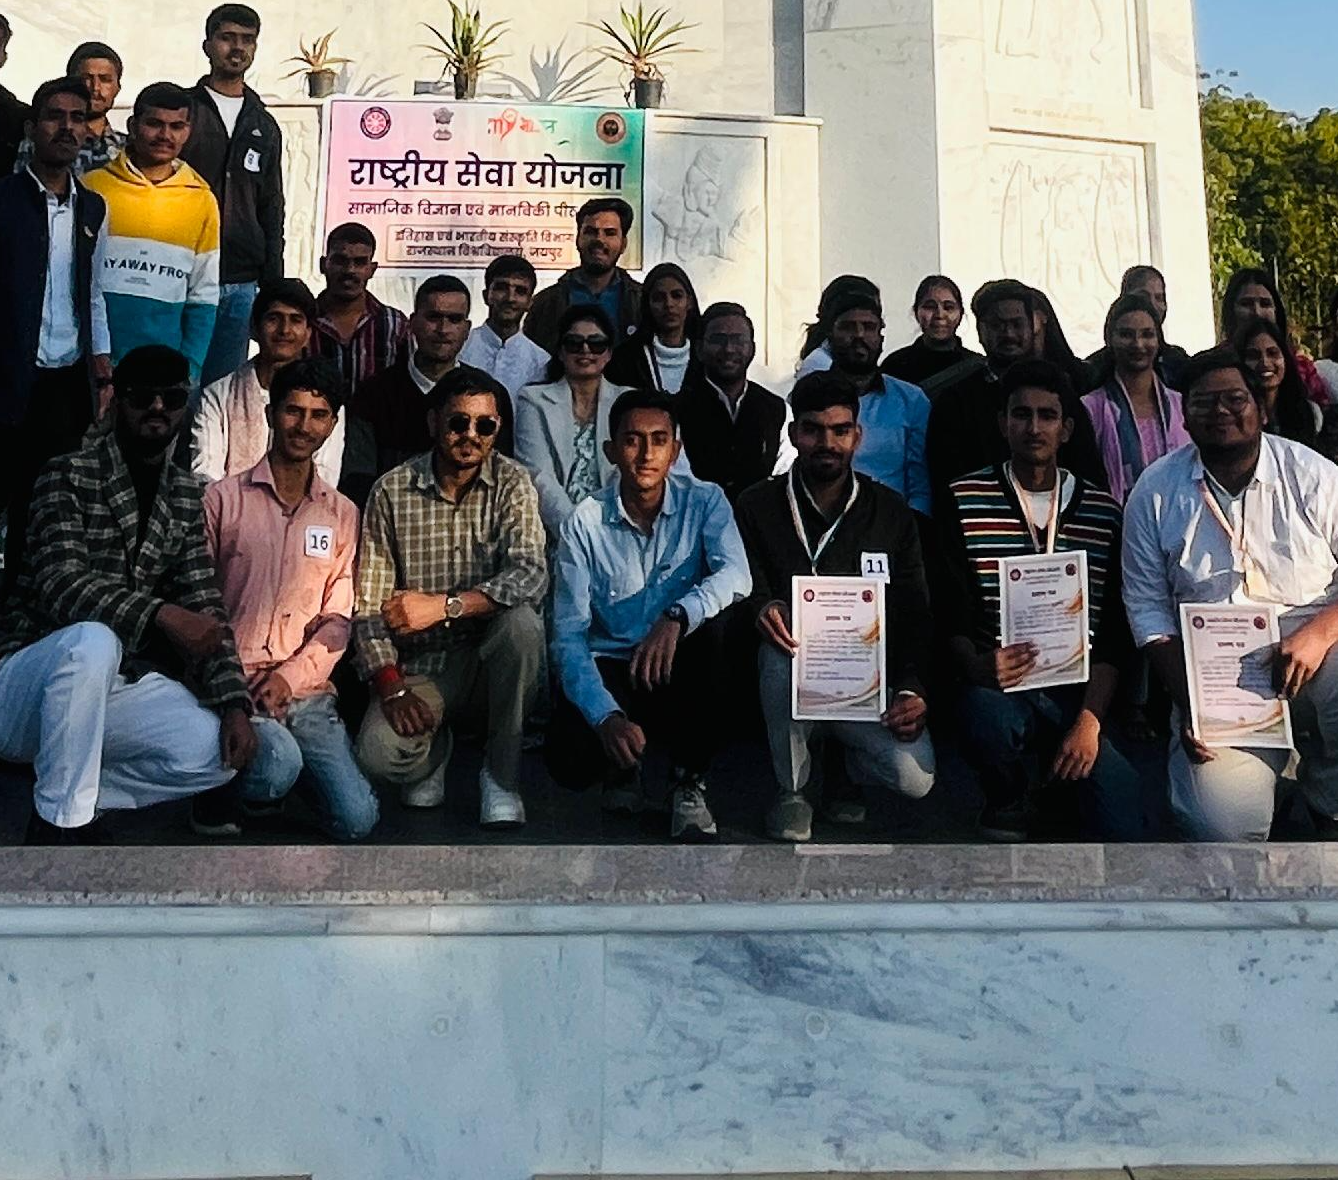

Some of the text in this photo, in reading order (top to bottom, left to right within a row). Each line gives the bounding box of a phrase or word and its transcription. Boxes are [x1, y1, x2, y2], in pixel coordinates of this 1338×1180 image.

[348, 149, 626, 191] राष्ट्रीय सेवा योजना
[348, 198, 413, 216] सामाजिक
[488, 200, 551, 217] मानविकी
[118, 259, 157, 273] AWAY
[310, 534, 329, 551] 16
[866, 559, 886, 574] 11
